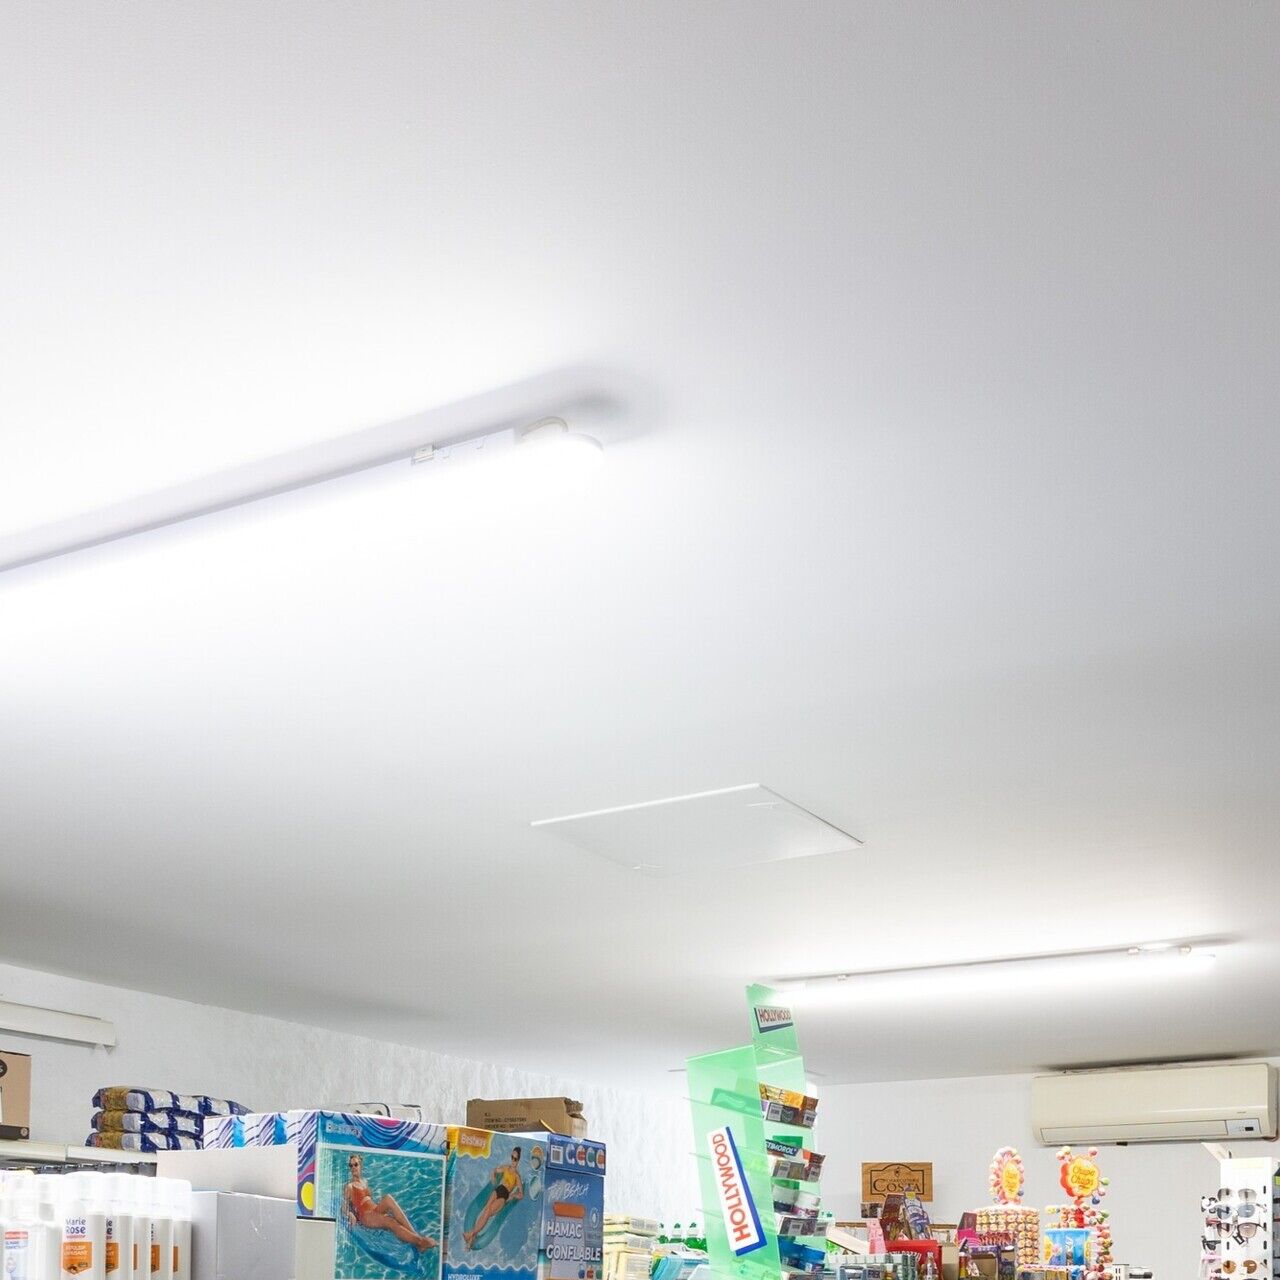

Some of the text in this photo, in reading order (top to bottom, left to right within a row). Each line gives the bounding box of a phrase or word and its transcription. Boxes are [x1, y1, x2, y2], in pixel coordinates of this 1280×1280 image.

[759, 1008, 792, 1022] HOLLYWOOD
[712, 1133, 752, 1243] HOLLYWOOD
[546, 1219, 583, 1238] HAMAC
[546, 1244, 602, 1262] GONFLABLE
